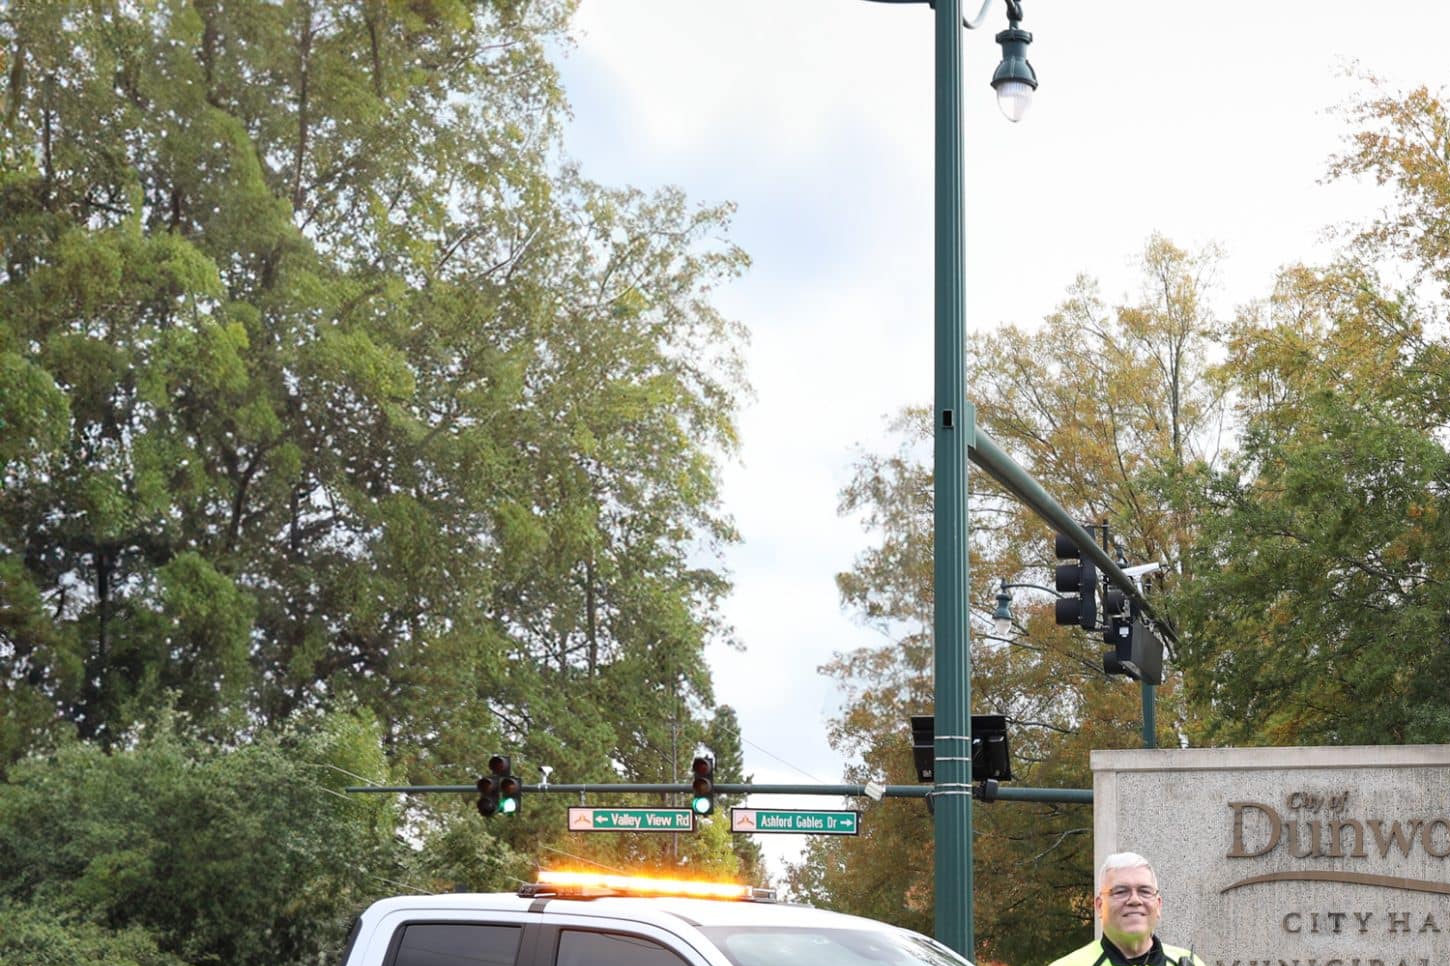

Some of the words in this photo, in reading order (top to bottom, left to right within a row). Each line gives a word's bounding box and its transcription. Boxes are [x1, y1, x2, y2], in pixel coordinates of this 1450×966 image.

[1286, 791, 1325, 814] City
[1328, 791, 1349, 814] of
[611, 812, 642, 828] Valley
[645, 813, 672, 826] View
[676, 813, 690, 826] Rd
[760, 815, 793, 828] Ashford
[796, 816, 824, 829] Gables
[827, 816, 837, 829] Dr
[1282, 911, 1374, 934] CITY
